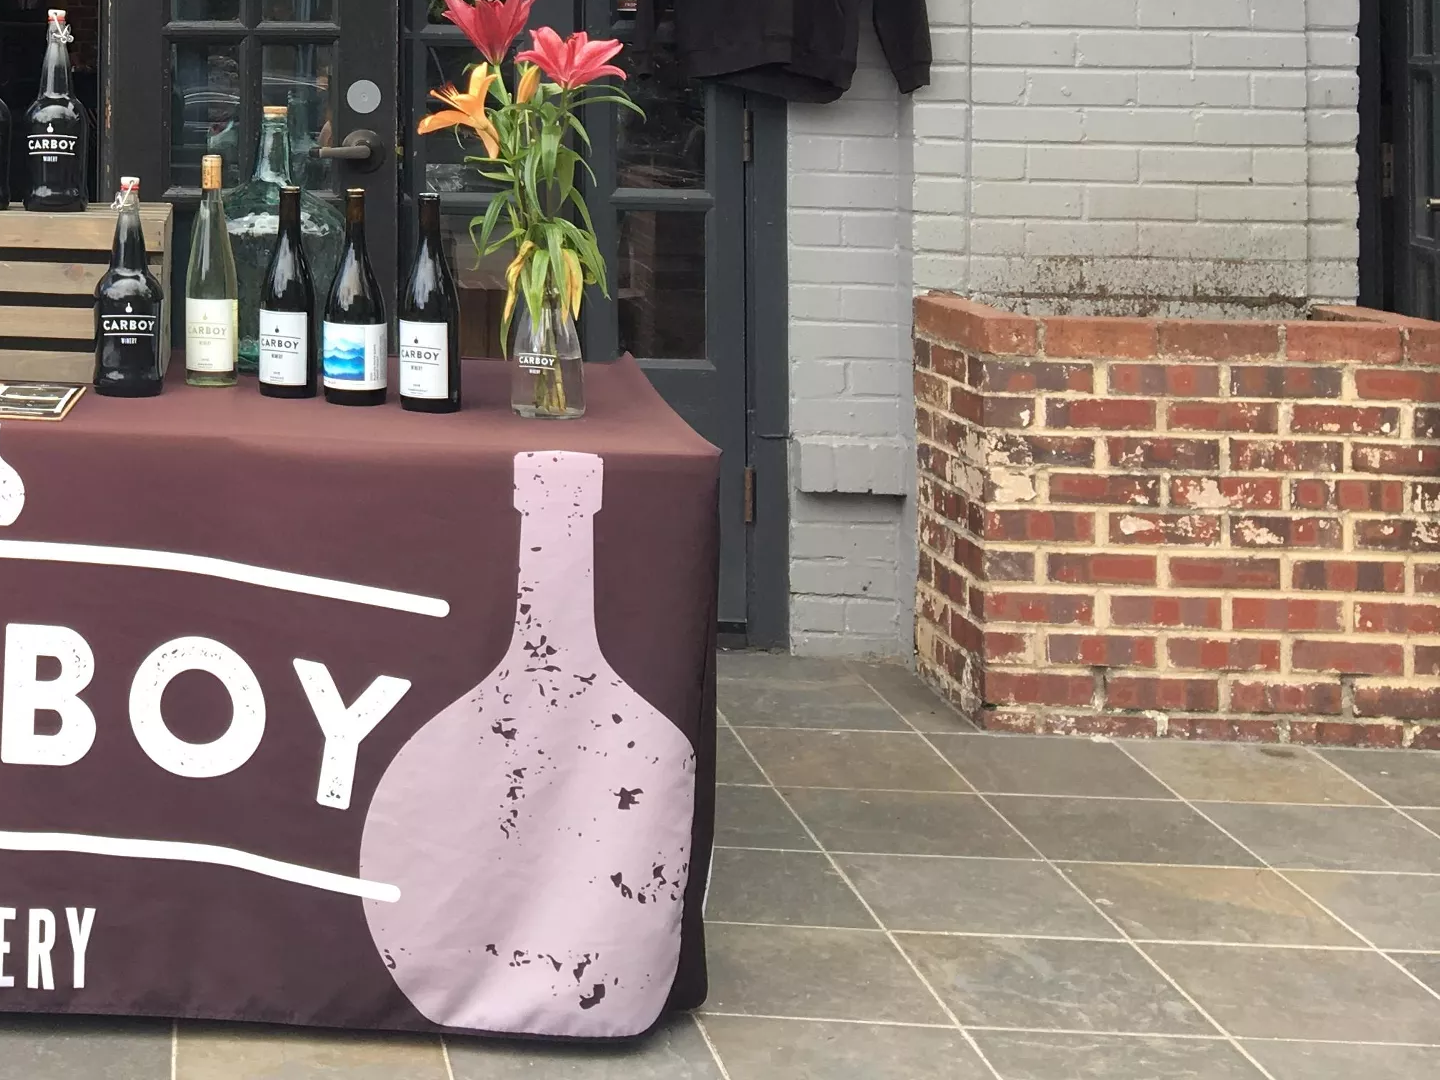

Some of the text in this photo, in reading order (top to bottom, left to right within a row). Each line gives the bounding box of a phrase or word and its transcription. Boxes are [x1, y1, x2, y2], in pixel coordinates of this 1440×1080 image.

[28, 139, 76, 150] CARBOY
[103, 320, 155, 331] CARBOY
[187, 326, 227, 336] CARBOY
[261, 338, 299, 350] CARBOY
[401, 349, 440, 361] CARBOY
[519, 356, 555, 366] CARBOY
